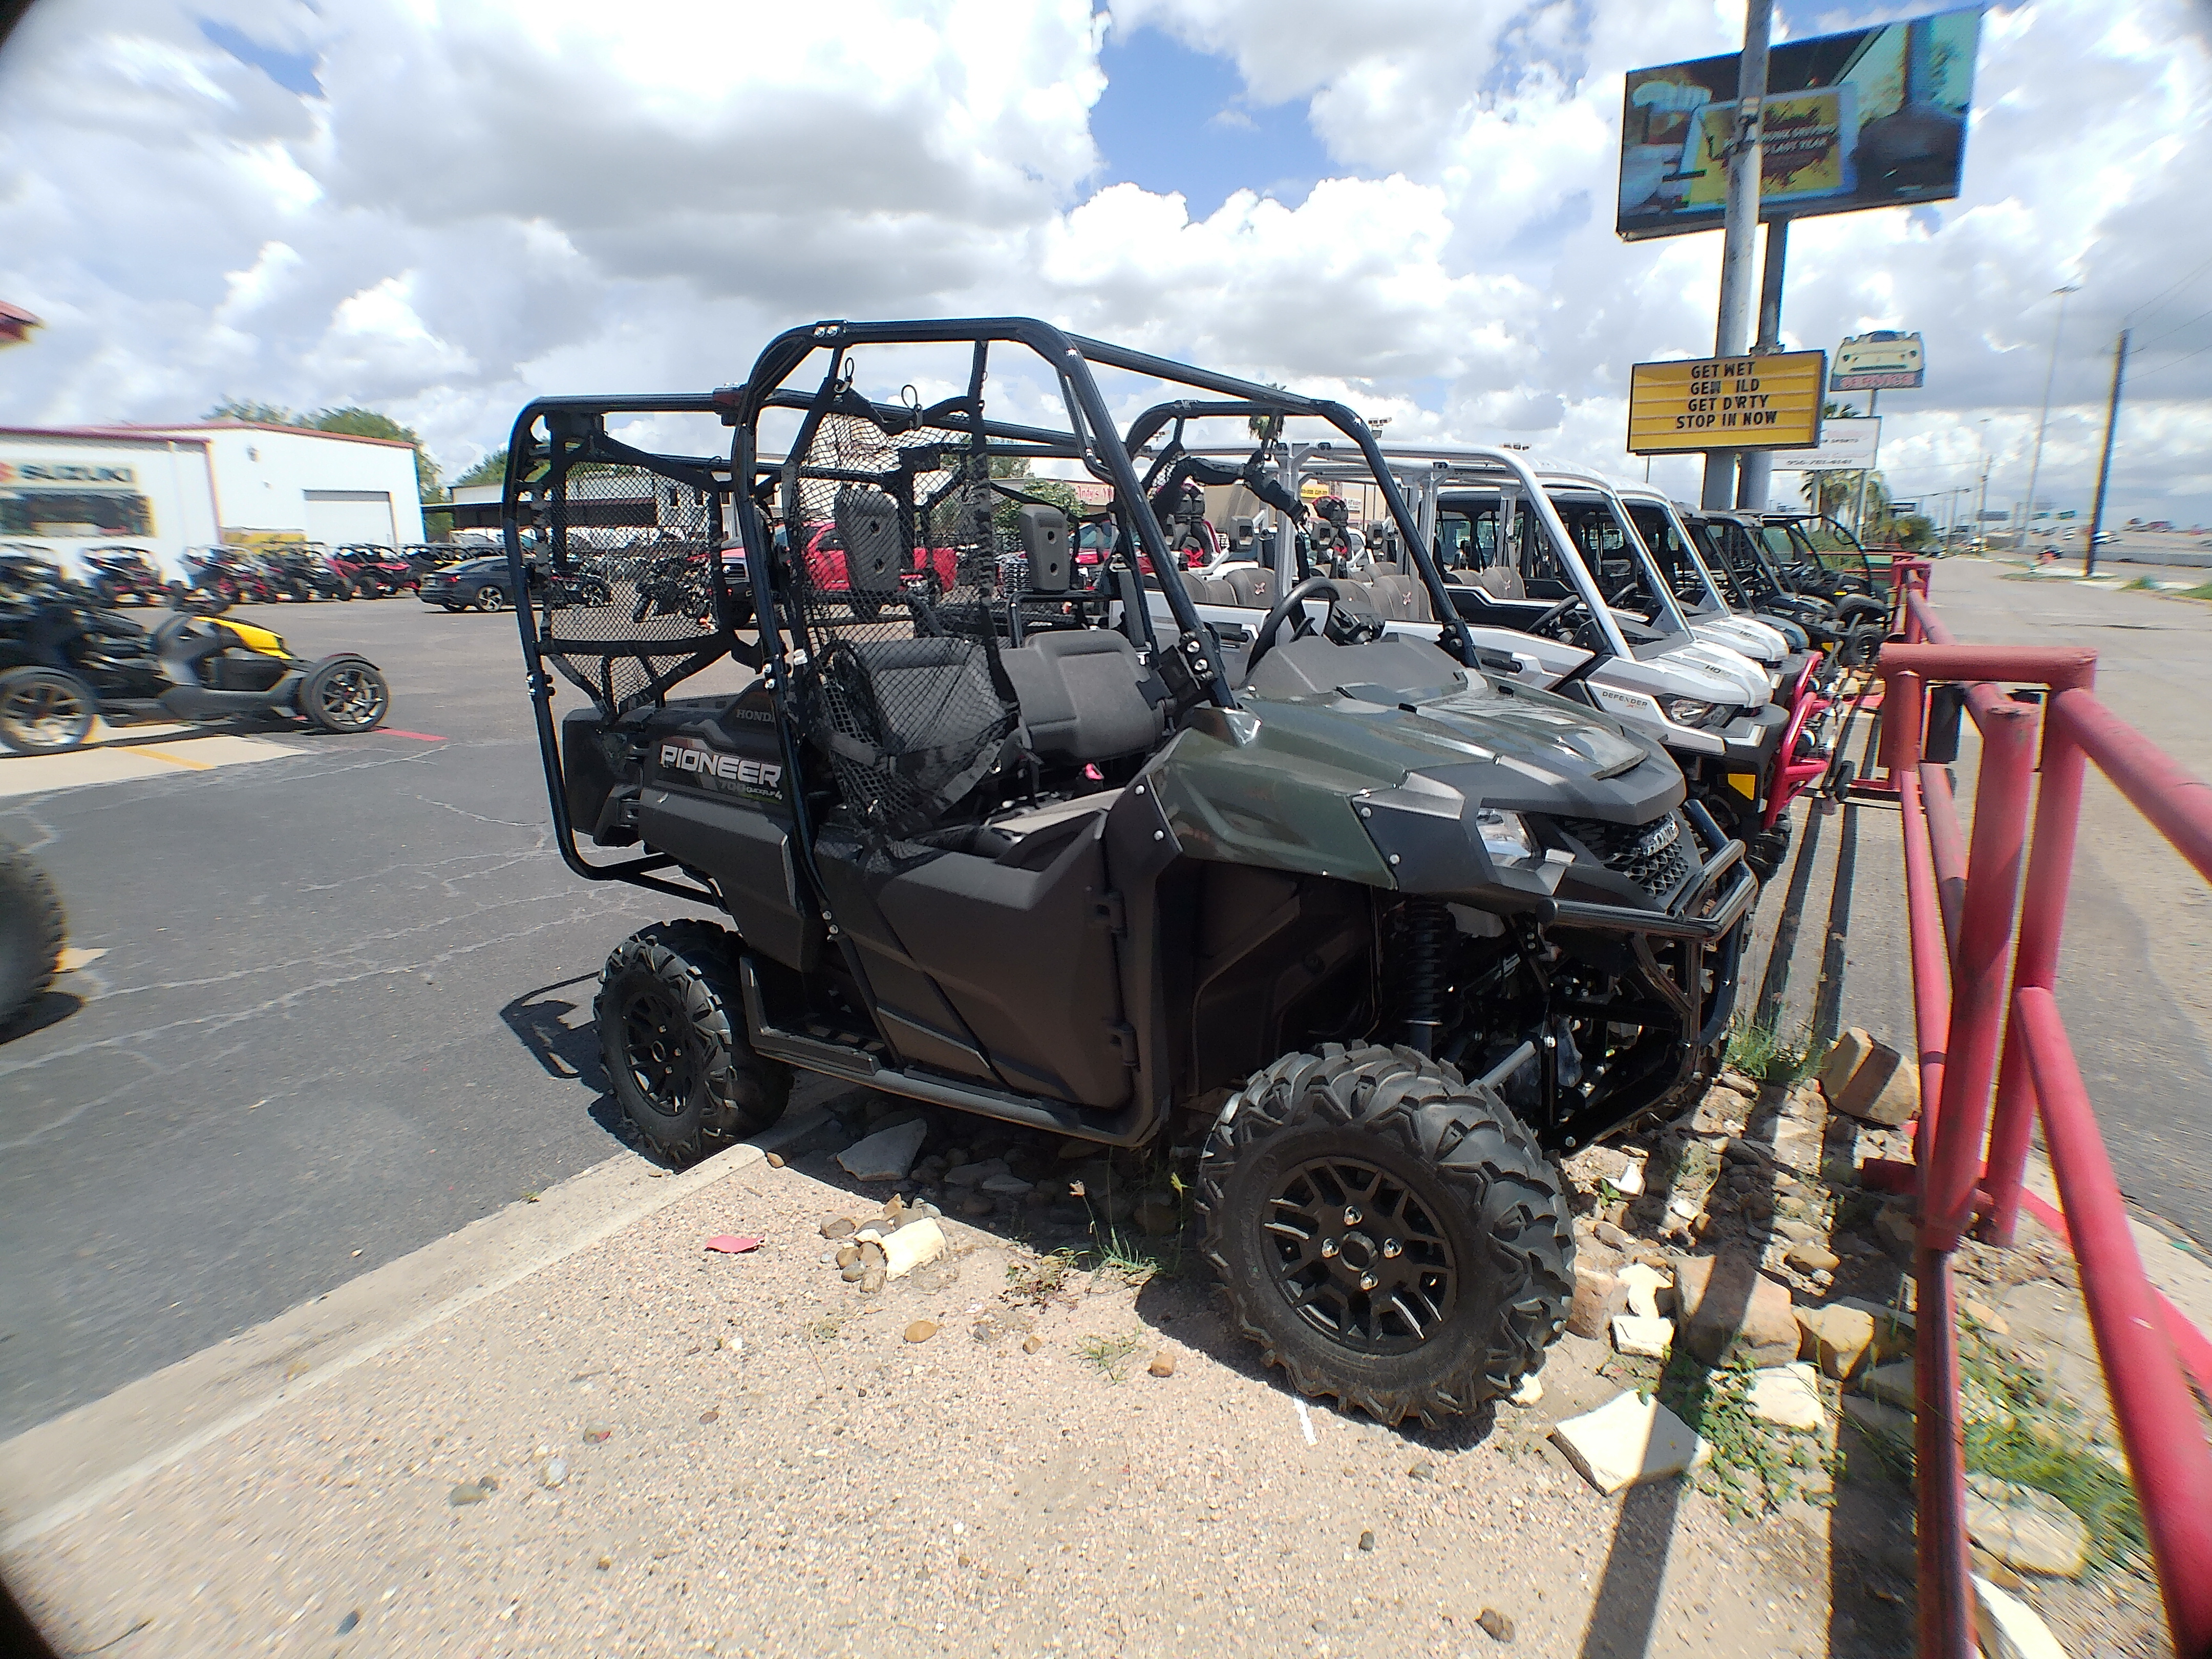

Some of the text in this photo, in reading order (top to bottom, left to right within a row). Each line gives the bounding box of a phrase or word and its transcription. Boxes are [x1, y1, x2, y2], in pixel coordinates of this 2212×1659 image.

[1691, 361, 1755, 378] GET WET
[1736, 377, 1760, 392] ILD
[1688, 398, 1717, 411] GET
[1676, 411, 1778, 429] STOP IN NOW
[1602, 691, 1647, 706] DEFENDER
[660, 745, 781, 788] PIONEER
